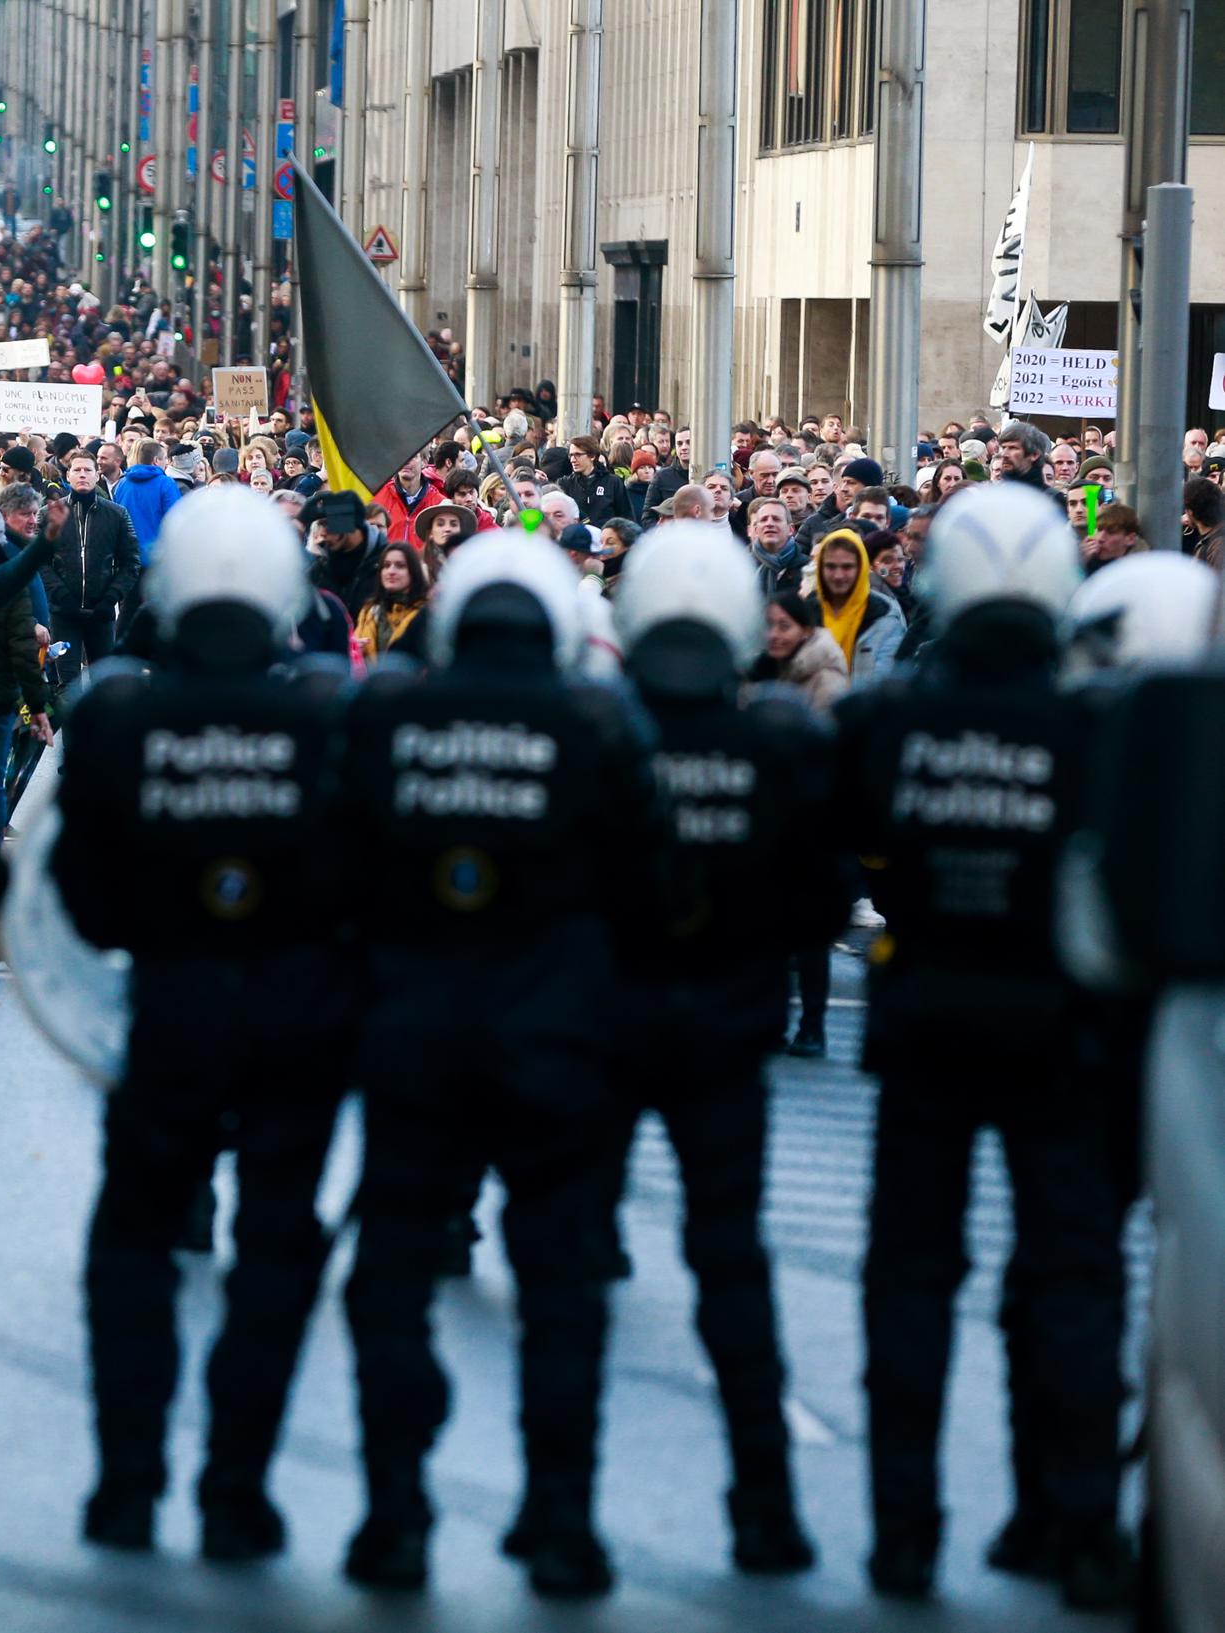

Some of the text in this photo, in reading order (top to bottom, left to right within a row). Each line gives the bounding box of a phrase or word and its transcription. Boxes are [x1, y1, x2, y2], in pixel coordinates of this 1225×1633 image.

[1015, 353, 1046, 367] 2020
[1062, 356, 1106, 370] HELD
[232, 375, 252, 385] NON
[1014, 371, 1044, 385] 2021
[1061, 375, 1103, 391] Egoïst
[5, 389, 24, 399] UNE
[228, 386, 255, 395] PASS
[1012, 391, 1044, 404] 2022
[4, 402, 32, 411] CONTRE
[36, 405, 50, 413] LES
[54, 406, 87, 415] PEUPLES
[53, 417, 80, 425] FONT
[143, 728, 297, 775] Police
[391, 722, 558, 773] Politie
[900, 729, 1054, 783] Police
[139, 773, 303, 820] Politie
[392, 770, 549, 820] Police
[892, 780, 1056, 833] Politie
